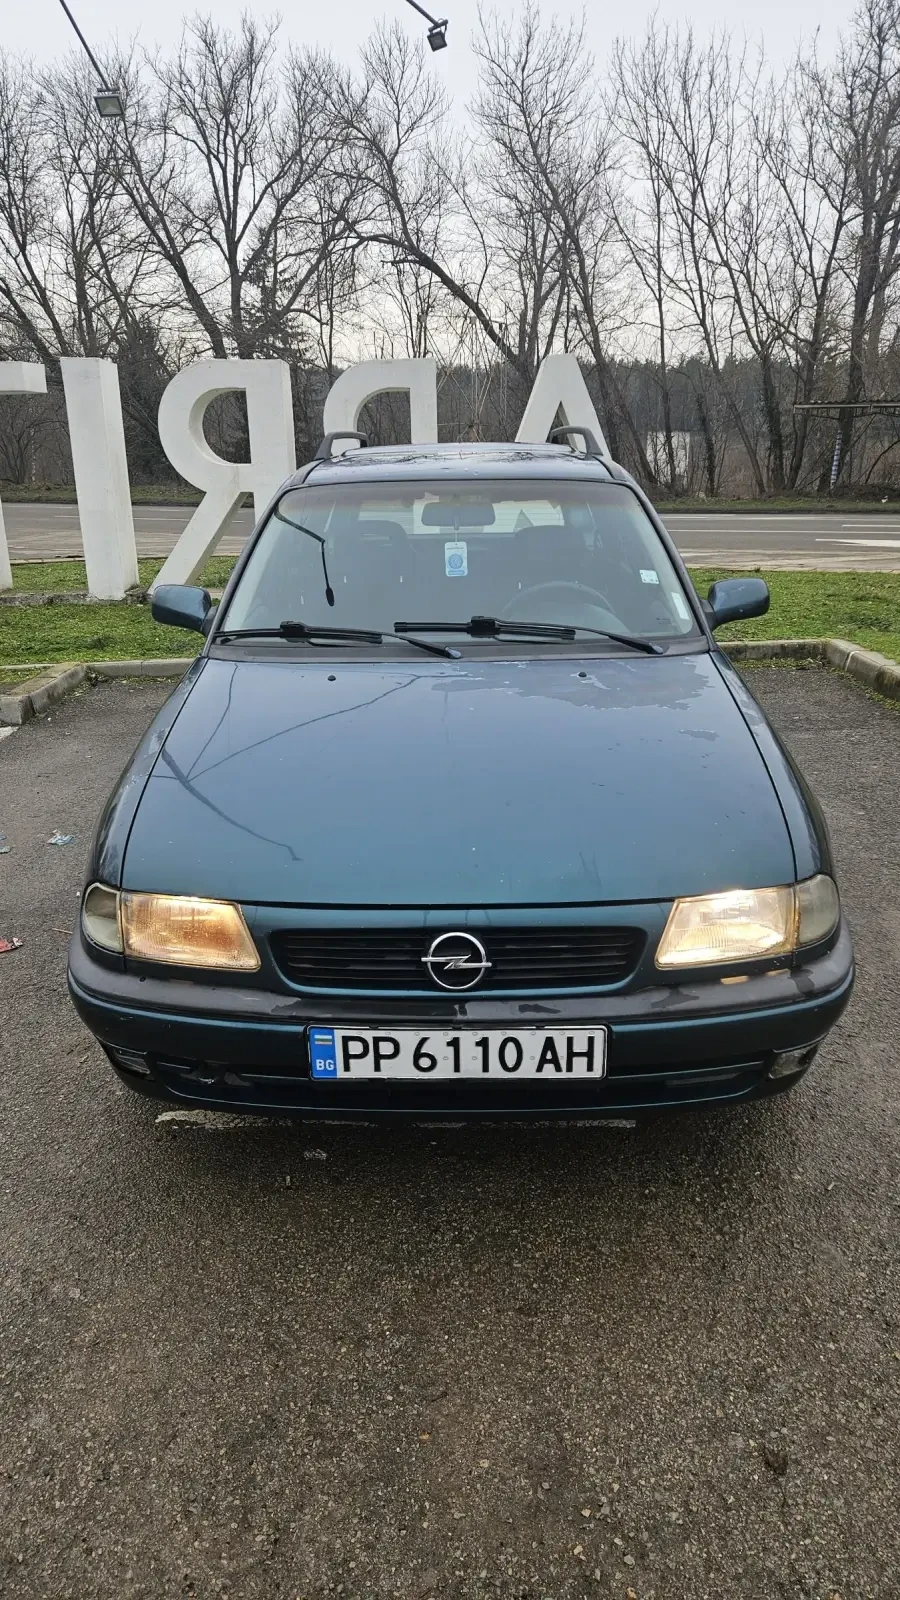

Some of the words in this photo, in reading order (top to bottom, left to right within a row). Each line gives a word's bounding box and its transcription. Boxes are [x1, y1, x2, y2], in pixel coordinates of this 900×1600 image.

[315, 1058, 335, 1071] BG
[341, 1035, 401, 1072] PP
[412, 1036, 524, 1073] 6110
[535, 1036, 595, 1073] AH
